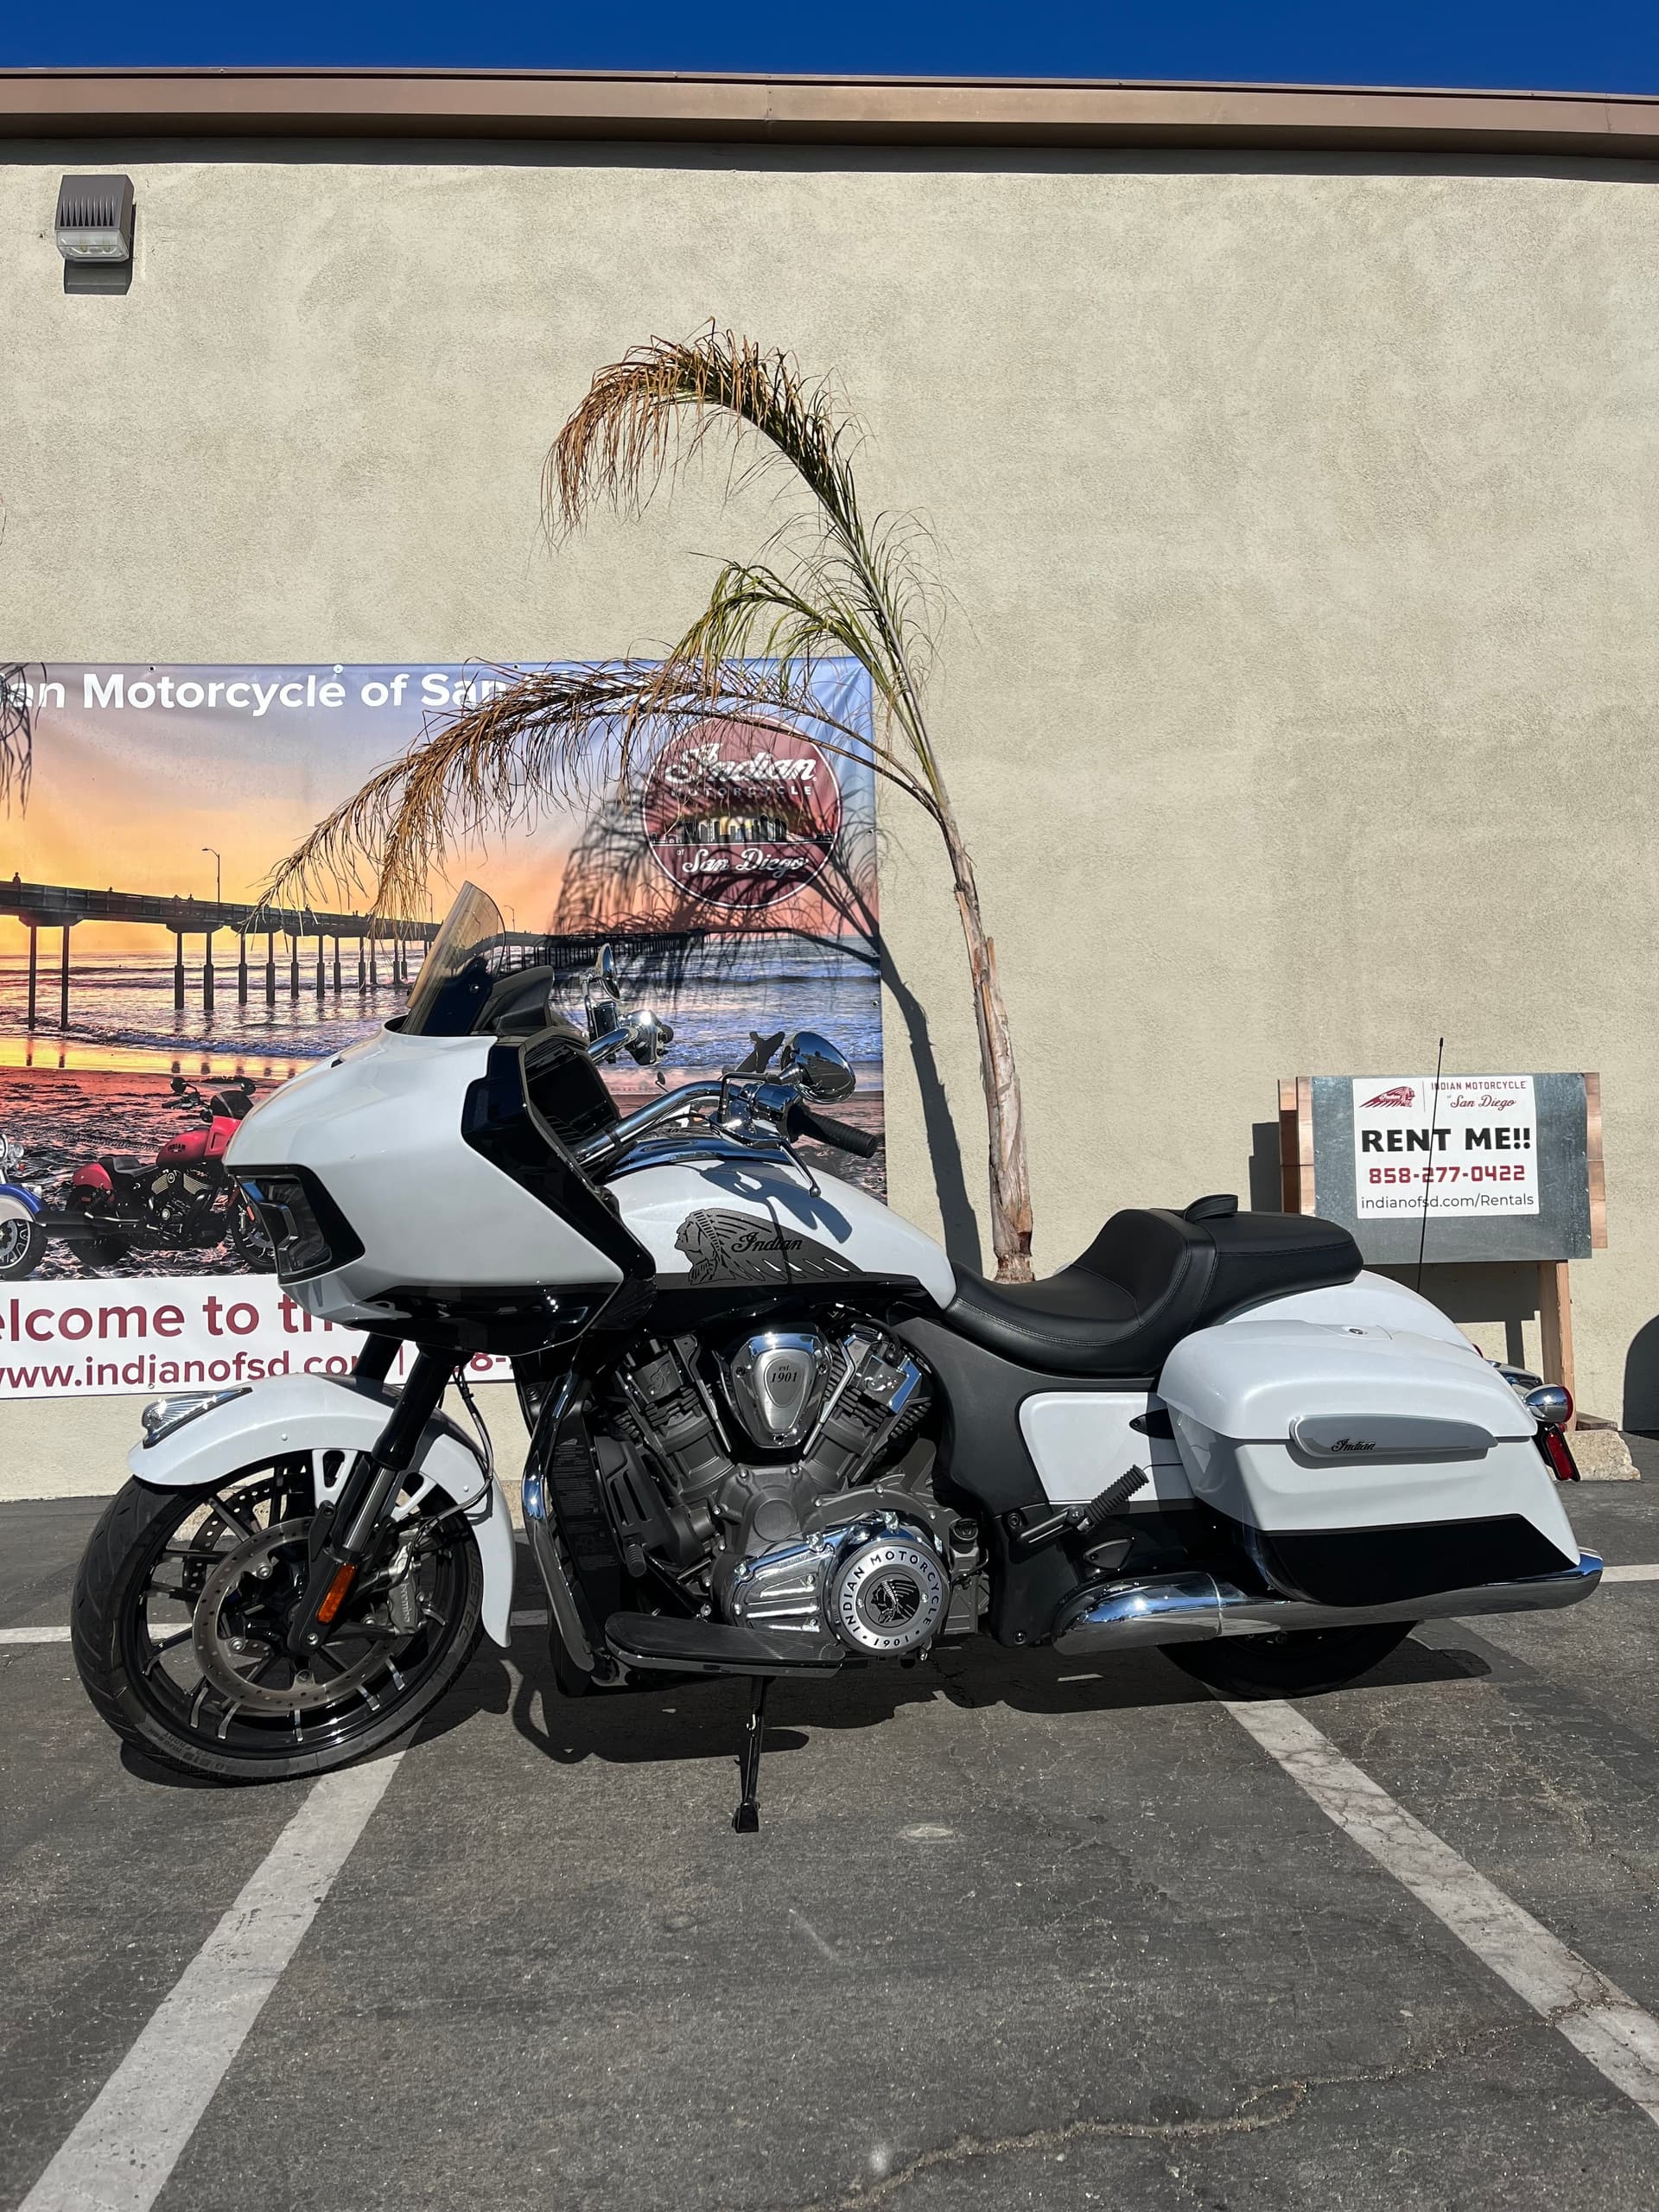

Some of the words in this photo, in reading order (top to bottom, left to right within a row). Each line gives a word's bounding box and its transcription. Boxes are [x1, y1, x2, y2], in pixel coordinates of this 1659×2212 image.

[83, 673, 346, 716] Motorcycle
[359, 673, 410, 707] of
[664, 743, 815, 784] Indian
[682, 849, 729, 873] San
[735, 848, 810, 878] Diego
[1431, 1082, 1462, 1090] INDIAN
[1465, 1080, 1527, 1090] MOTORCYCLE
[1450, 1094, 1475, 1108] San
[1478, 1094, 1516, 1111] Diego
[1361, 1128, 1452, 1153] RENT
[1465, 1127, 1531, 1151] ME!!
[1369, 1165, 1525, 1184] 858-277-0422
[1361, 1193, 1534, 1210] indianofsd.com/Rentals
[731, 1232, 803, 1252] Indian
[202, 1295, 260, 1335] to
[772, 1372, 798, 1382] 1901
[1331, 1438, 1376, 1452] Indian
[842, 1566, 865, 1633] INDIAN
[870, 1550, 939, 1625] MOTORCYCLE
[874, 1635, 910, 1646] 1901
